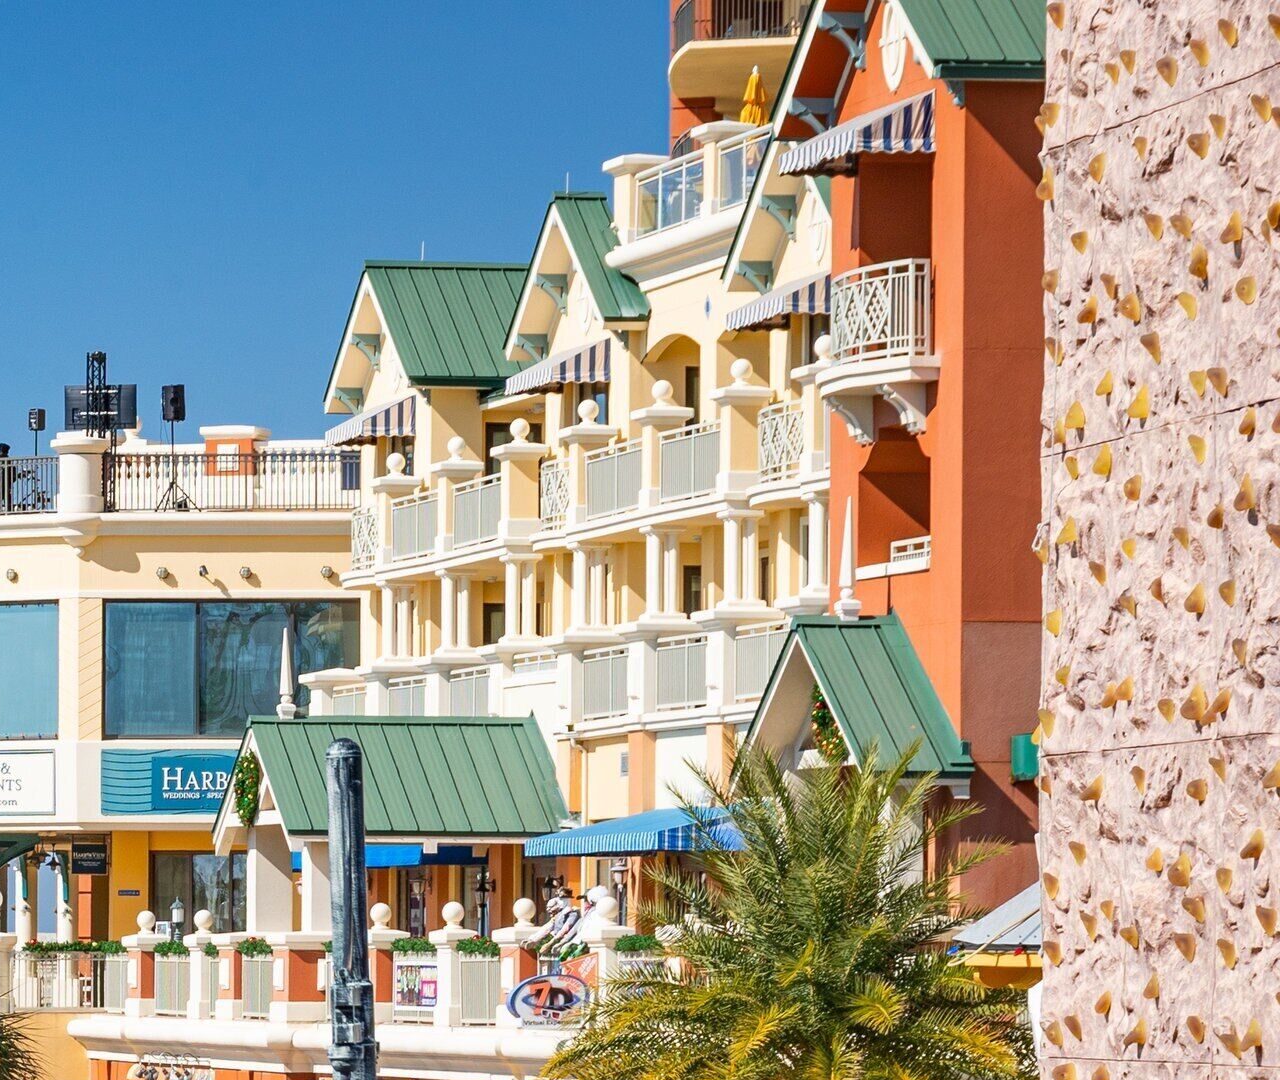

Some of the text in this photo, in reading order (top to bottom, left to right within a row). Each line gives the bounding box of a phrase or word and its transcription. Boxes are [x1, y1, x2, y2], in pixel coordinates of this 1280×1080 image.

[0, 762, 12, 775] &
[161, 766, 231, 791] HARB
[162, 791, 200, 799] WEDDINGS
